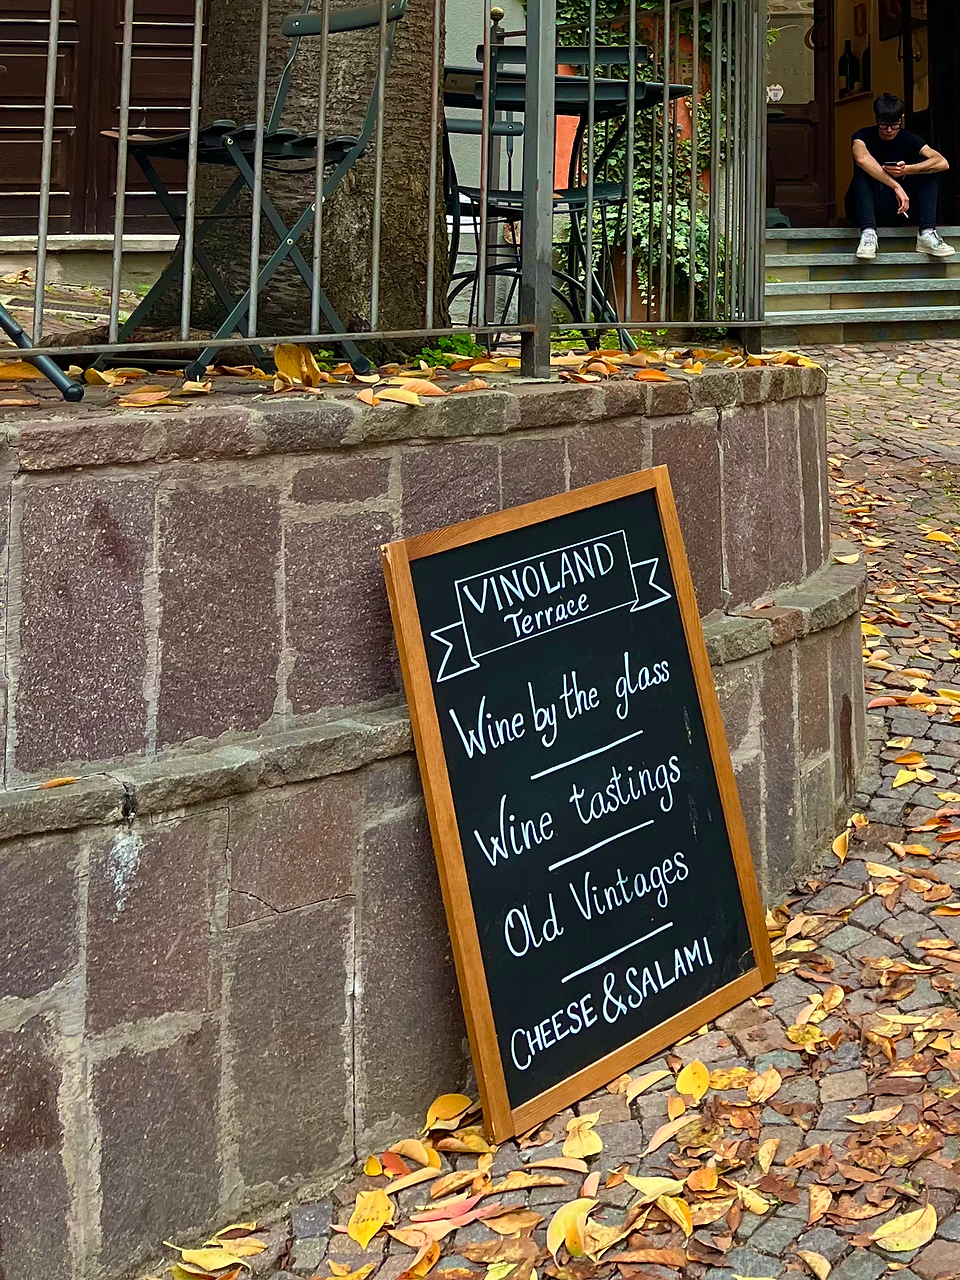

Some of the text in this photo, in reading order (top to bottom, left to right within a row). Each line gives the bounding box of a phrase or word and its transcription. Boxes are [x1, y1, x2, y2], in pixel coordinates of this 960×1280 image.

[462, 542, 615, 614] VINOLAND
[503, 593, 590, 638] Terrace
[448, 651, 670, 759] Wine by the glass
[473, 755, 681, 867] Wine tastings
[504, 851, 689, 957] Old Vintages
[510, 992, 598, 1071] CHEESE
[625, 936, 714, 1009] SALAMI
